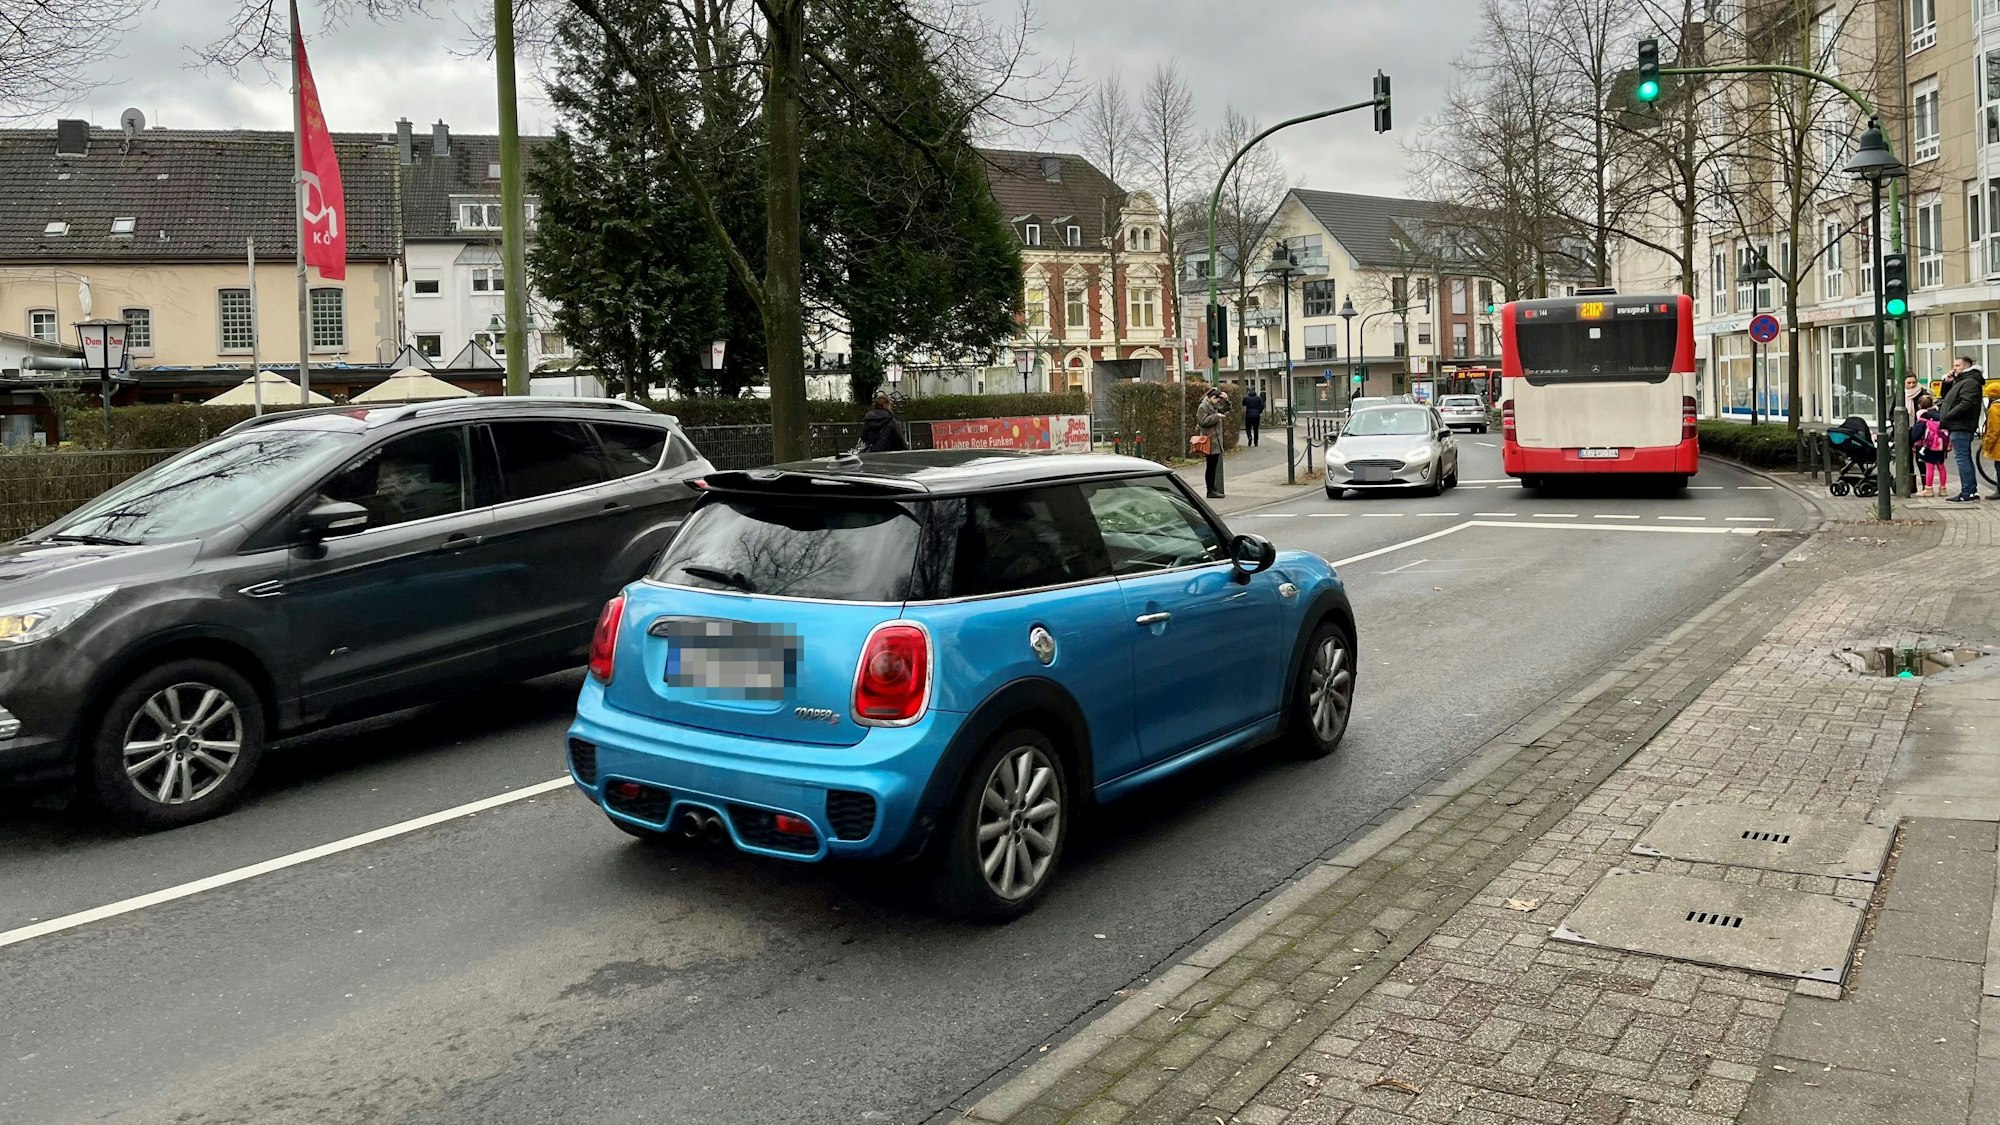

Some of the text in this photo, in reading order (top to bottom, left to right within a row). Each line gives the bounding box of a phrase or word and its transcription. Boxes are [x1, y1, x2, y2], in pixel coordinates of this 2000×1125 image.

[1616, 303, 1650, 316] wupsi
[85, 336, 102, 346] Dom
[109, 336, 123, 346] Dom
[950, 438, 970, 449] Jahre
[971, 437, 988, 448] Rote
[988, 435, 1014, 447] Funken
